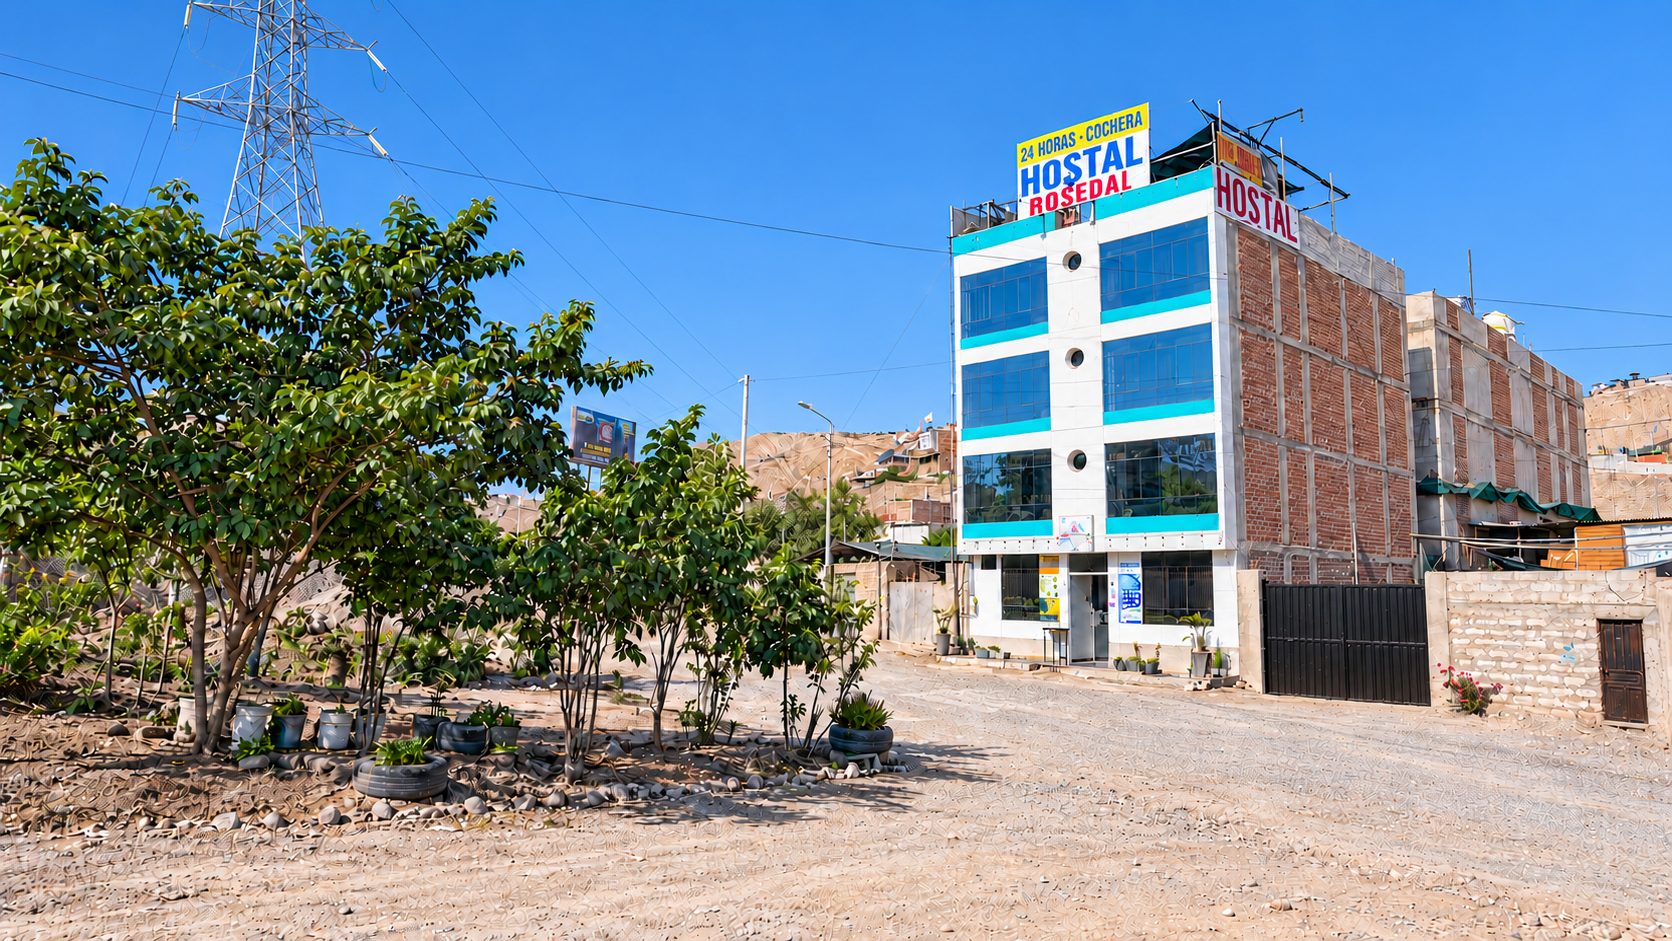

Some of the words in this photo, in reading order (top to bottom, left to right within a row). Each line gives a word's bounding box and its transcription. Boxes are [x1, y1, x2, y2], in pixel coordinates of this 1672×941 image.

[1020, 145, 1034, 163] 24
[1038, 132, 1076, 156] HORAS
[1085, 111, 1143, 142] COCHERA
[1021, 136, 1143, 198] HOSTAL
[1029, 170, 1132, 216] ROSEDAL
[1216, 167, 1298, 243] HOSTAL
